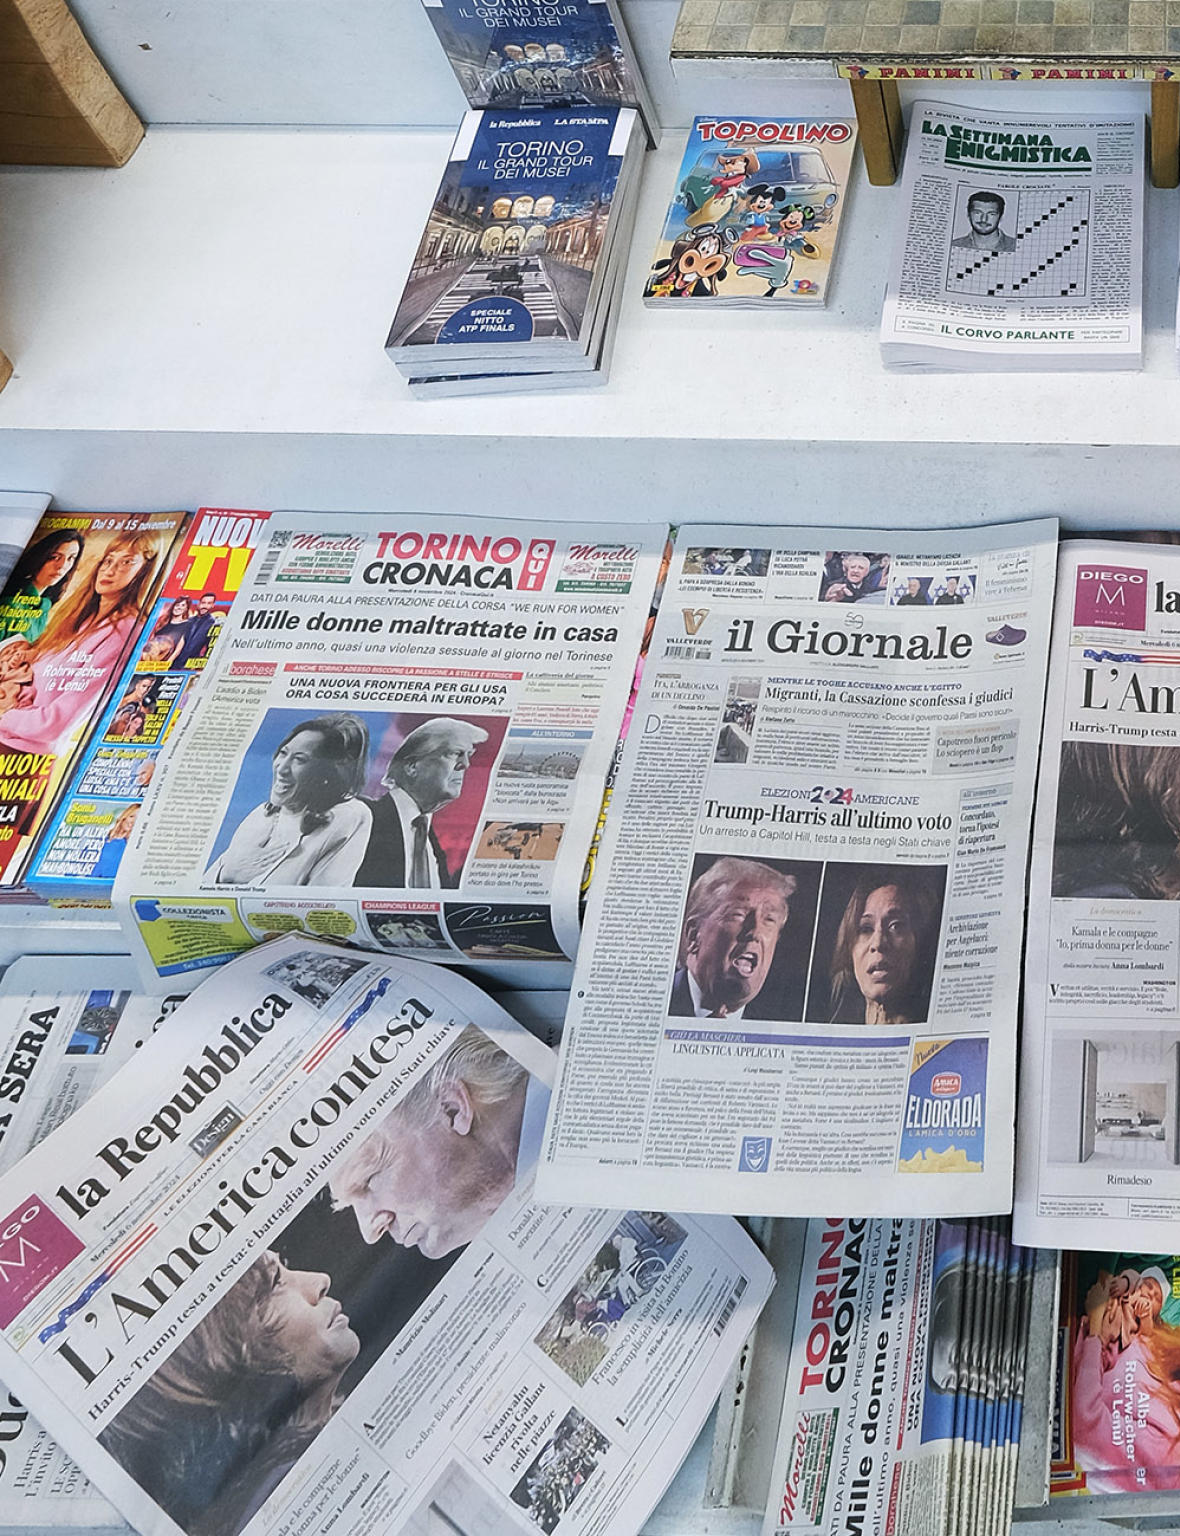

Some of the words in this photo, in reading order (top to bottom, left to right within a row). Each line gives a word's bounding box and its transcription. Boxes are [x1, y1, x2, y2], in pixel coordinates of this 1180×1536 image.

[459, 8, 473, 18] IL
[476, 8, 531, 17] GRAND
[534, 6, 578, 16] TOUR
[484, 17, 510, 27] DEI
[514, 16, 561, 27] MUSEI
[878, 66, 976, 80] PANINI
[697, 122, 852, 144] TOPOLINO
[922, 120, 947, 136] LA
[949, 125, 1053, 146] SETTIMANA
[496, 140, 584, 159] TORINO
[945, 137, 1091, 162] ENIGMISTICA
[470, 308, 512, 316] SPECIALE
[474, 316, 504, 324] NITTO
[459, 323, 479, 332] ATP
[481, 322, 515, 332] FINALS
[940, 325, 951, 335] IL
[956, 326, 1002, 338] CORVO
[1006, 328, 1075, 340] PARLANTE
[375, 532, 520, 563] TORINO
[362, 562, 514, 590] CRONACA
[1080, 570, 1143, 585] DIEGO
[251, 593, 274, 603] DATI
[274, 594, 288, 603] DA
[291, 594, 325, 604] PAURA
[327, 596, 351, 604] ALLA
[355, 597, 434, 607] PRESENTAZIONE
[438, 599, 468, 609] DELLA
[472, 601, 506, 611] CORSA
[240, 610, 300, 631] Mille
[306, 612, 382, 634] donne
[388, 615, 526, 640] maltrattate
[533, 621, 556, 641] in
[564, 627, 618, 642] casa
[724, 620, 754, 653] il
[766, 619, 973, 661] Giornale
[1070, 721, 1148, 739] Harris-Trump
[705, 800, 826, 825] Trump-Harris
[831, 807, 912, 830] all'ultimo
[918, 813, 952, 830] voto
[56, 1177, 111, 1222] la
[95, 987, 293, 1182] Repubblica
[906, 1094, 982, 1128] ELDORADA
[1106, 1174, 1152, 1186] Rimadesio
[53, 1143, 298, 1389] L'America
[289, 996, 435, 1150] contesa
